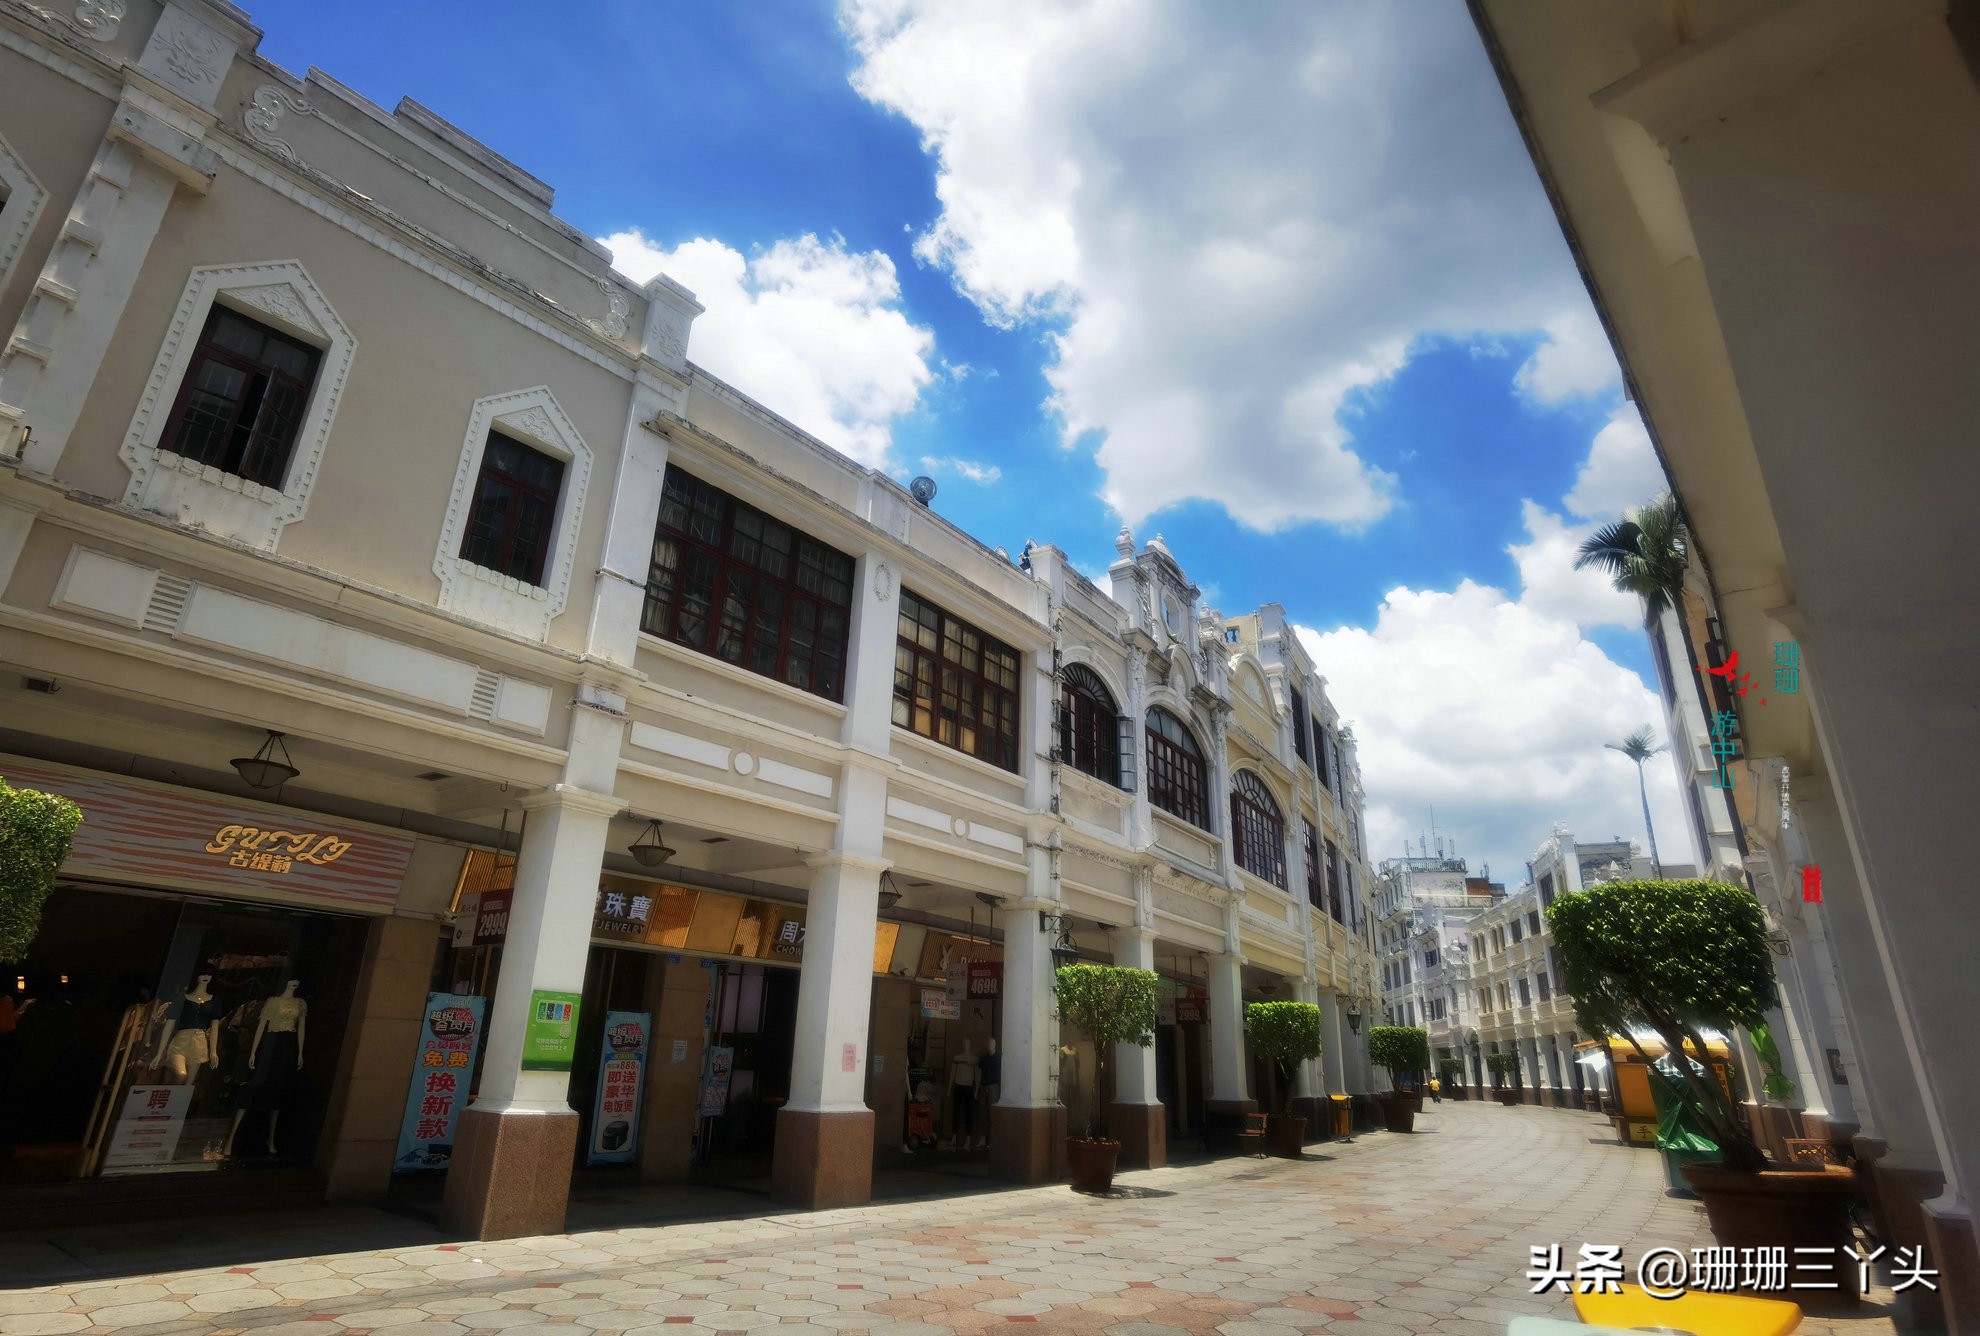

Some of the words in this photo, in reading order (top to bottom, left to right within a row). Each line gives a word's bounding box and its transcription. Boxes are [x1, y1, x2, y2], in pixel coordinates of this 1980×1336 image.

[971, 977, 997, 994] 4699
[423, 1050, 470, 1068] 免费
[607, 1071, 637, 1084] 即送
[147, 1089, 171, 1109] 聘
[605, 1084, 635, 1099] 豪华
[416, 1072, 457, 1140] 换新款
[603, 1099, 634, 1113] 电饭煲
